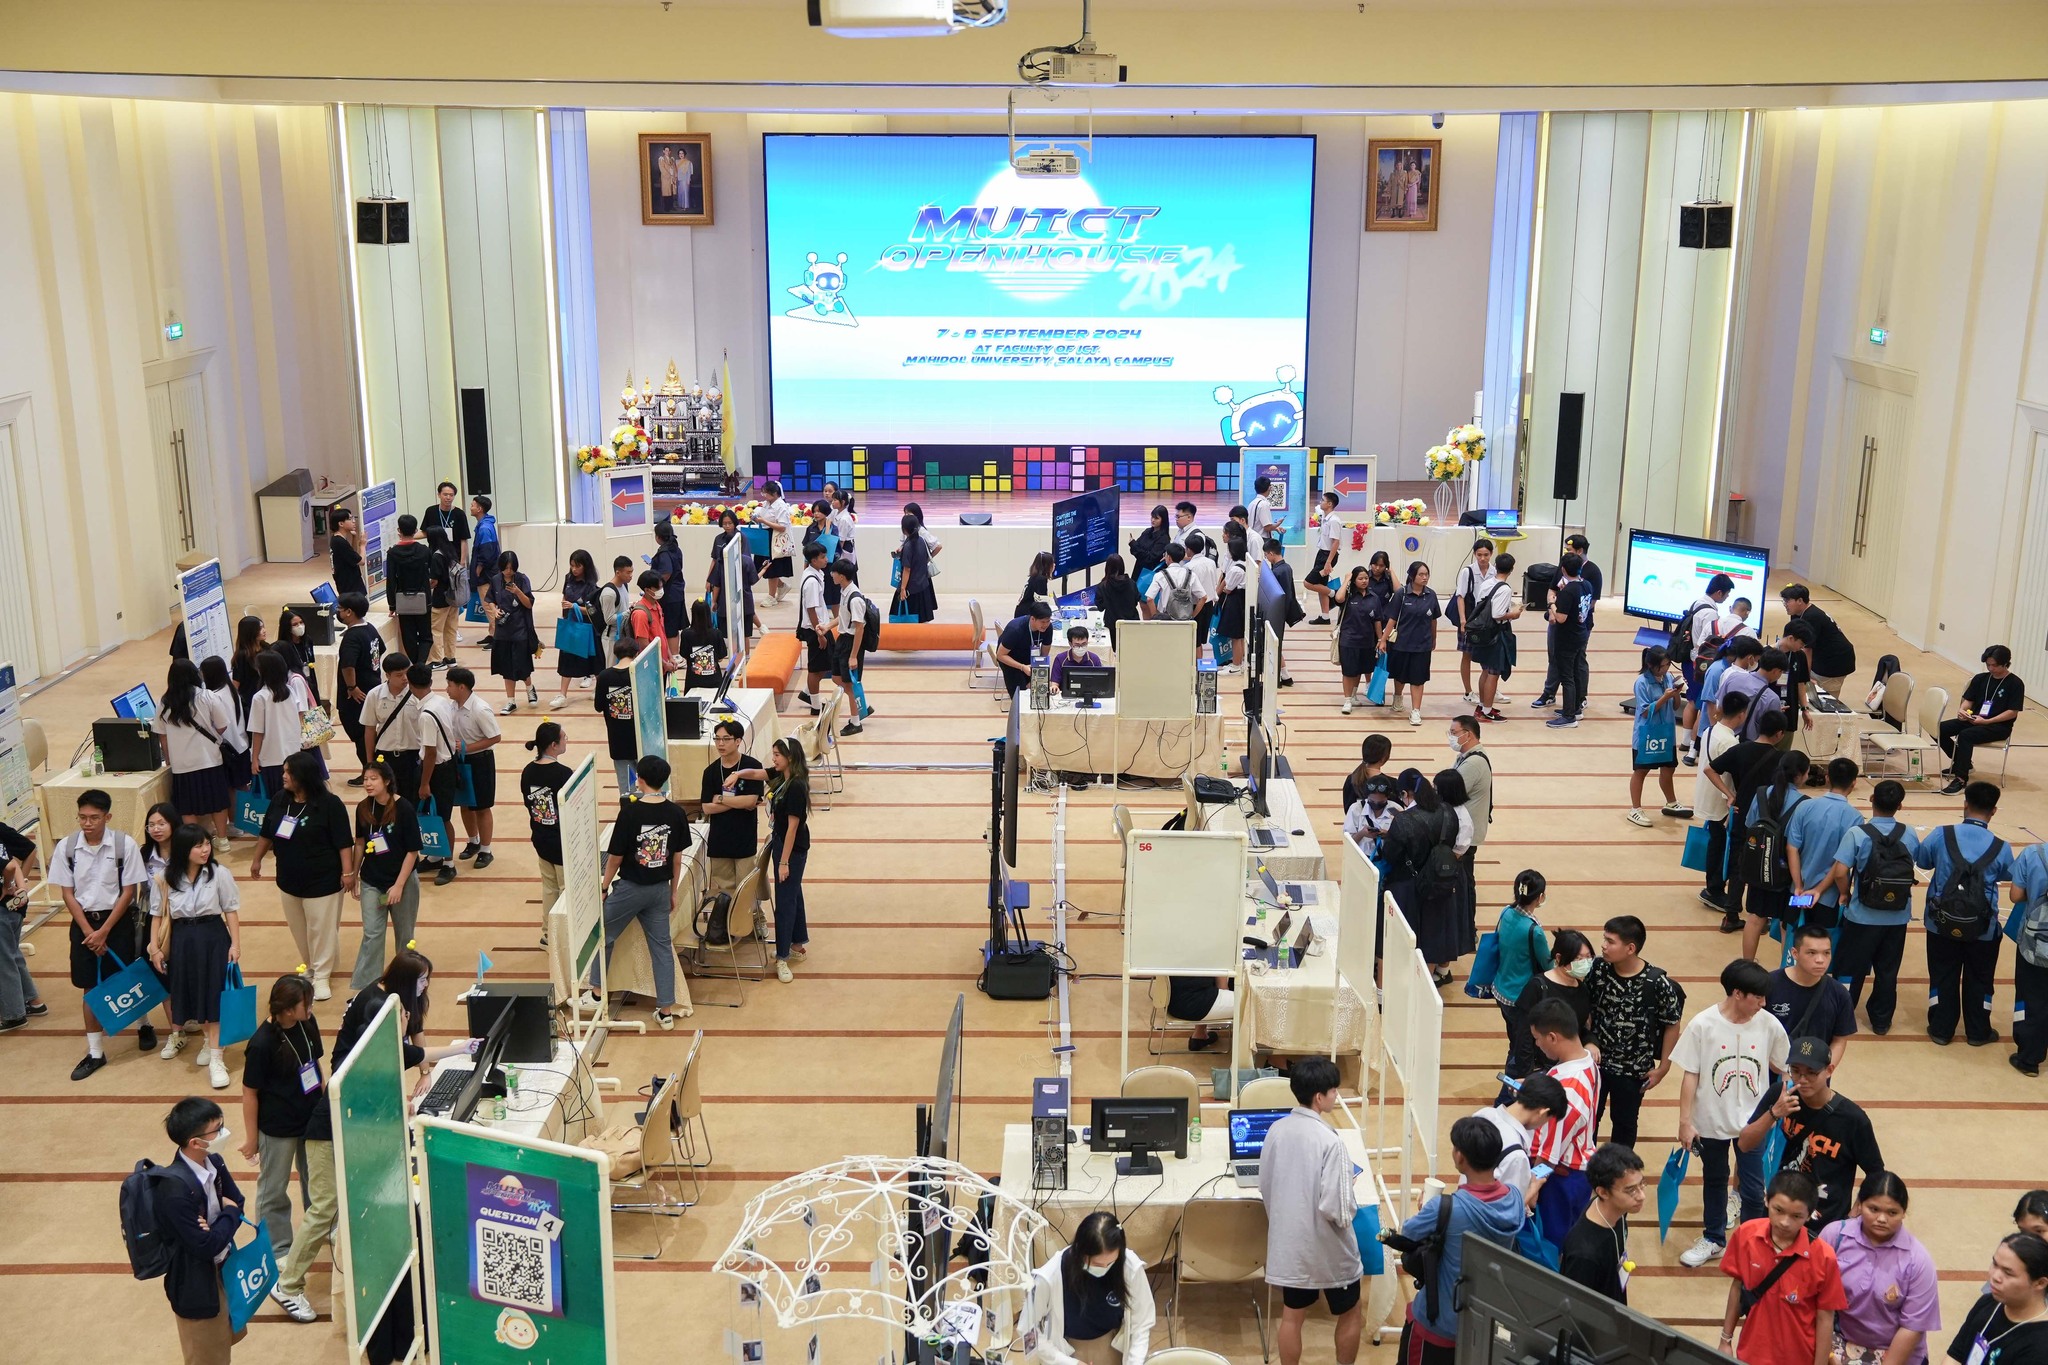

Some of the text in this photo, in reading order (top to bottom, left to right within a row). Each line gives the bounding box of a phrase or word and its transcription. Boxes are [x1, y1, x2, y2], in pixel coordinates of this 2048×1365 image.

[908, 205, 1162, 242] MUICT
[880, 244, 1188, 272] OPENHOUSE
[1118, 243, 1244, 311] 2024
[937, 329, 950, 339] 7
[964, 329, 977, 339] 8
[981, 329, 1089, 340] SEPTEMBER
[1093, 329, 1142, 340] 2024
[972, 345, 993, 355] AT
[995, 345, 1053, 355] FACULTY
[1054, 345, 1075, 355] OF
[903, 356, 968, 366] MAHIDOL
[1054, 356, 1111, 366] SALAYA
[1114, 356, 1174, 366] CAMPUS
[1139, 842, 1152, 851] 56
[486, 1181, 535, 1198] MUICT
[480, 1207, 554, 1232] QUESTION 4
